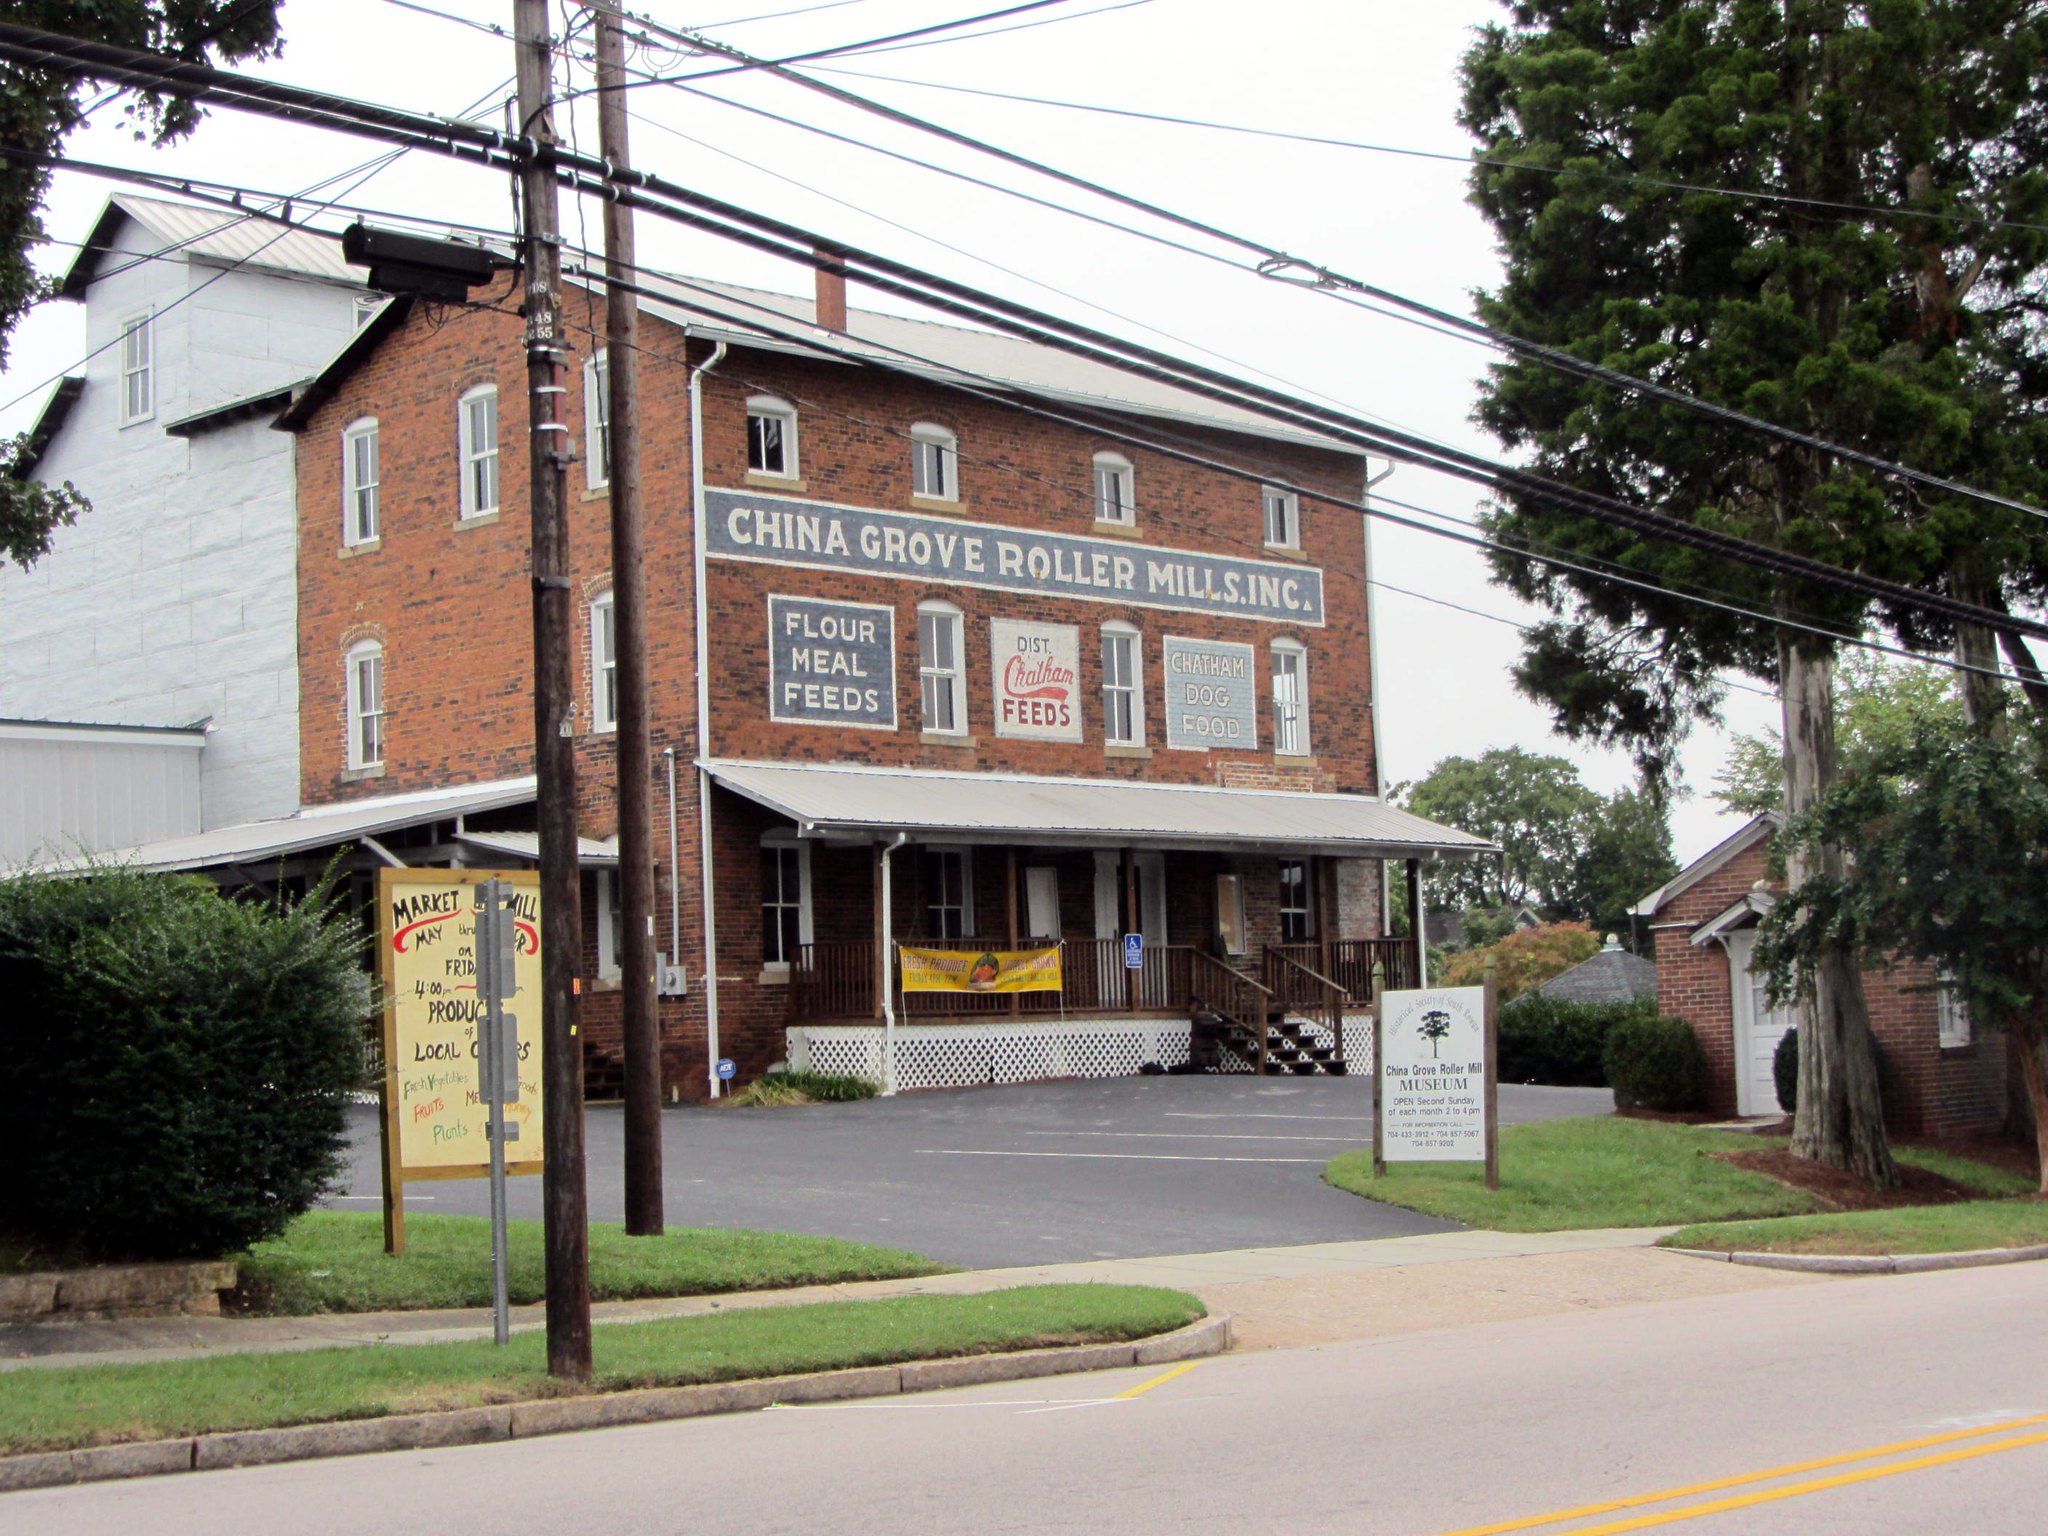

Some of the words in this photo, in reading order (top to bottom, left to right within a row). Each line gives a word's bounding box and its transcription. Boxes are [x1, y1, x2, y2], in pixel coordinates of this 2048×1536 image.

[728, 508, 850, 556] CHINA
[860, 525, 984, 573] GROVE
[997, 541, 1135, 590] ROLLER
[786, 612, 875, 643] FLOUR
[1017, 636, 1051, 655] DIST.
[792, 647, 868, 677] MEAL
[1171, 651, 1245, 679] CHATHAM
[1004, 655, 1074, 700] Chatham
[784, 682, 879, 712] FEEDS
[1185, 683, 1231, 708] DOG
[1003, 698, 1071, 727] FEEDS
[1182, 713, 1241, 739] FOOD
[392, 890, 459, 929] MARKET
[416, 925, 442, 951] MAY
[459, 946, 473, 957] on
[415, 980, 442, 999] 4:00
[464, 1027, 474, 1040] of
[415, 1042, 461, 1062] LOCAL
[1386, 1065, 1408, 1076] China
[1412, 1064, 1436, 1076] Grove
[1440, 1063, 1464, 1074] Roller
[1468, 1062, 1482, 1074] Mill
[1400, 1078, 1468, 1091] MUSEUM
[1388, 1108, 1396, 1116] of
[1399, 1108, 1416, 1116] each
[1420, 1107, 1443, 1115] month
[1453, 1107, 1460, 1115] to
[1469, 1107, 1480, 1116] pm
[1417, 1097, 1445, 1105] Second
[1448, 1096, 1475, 1105] Sunday
[433, 1119, 468, 1145] Plants
